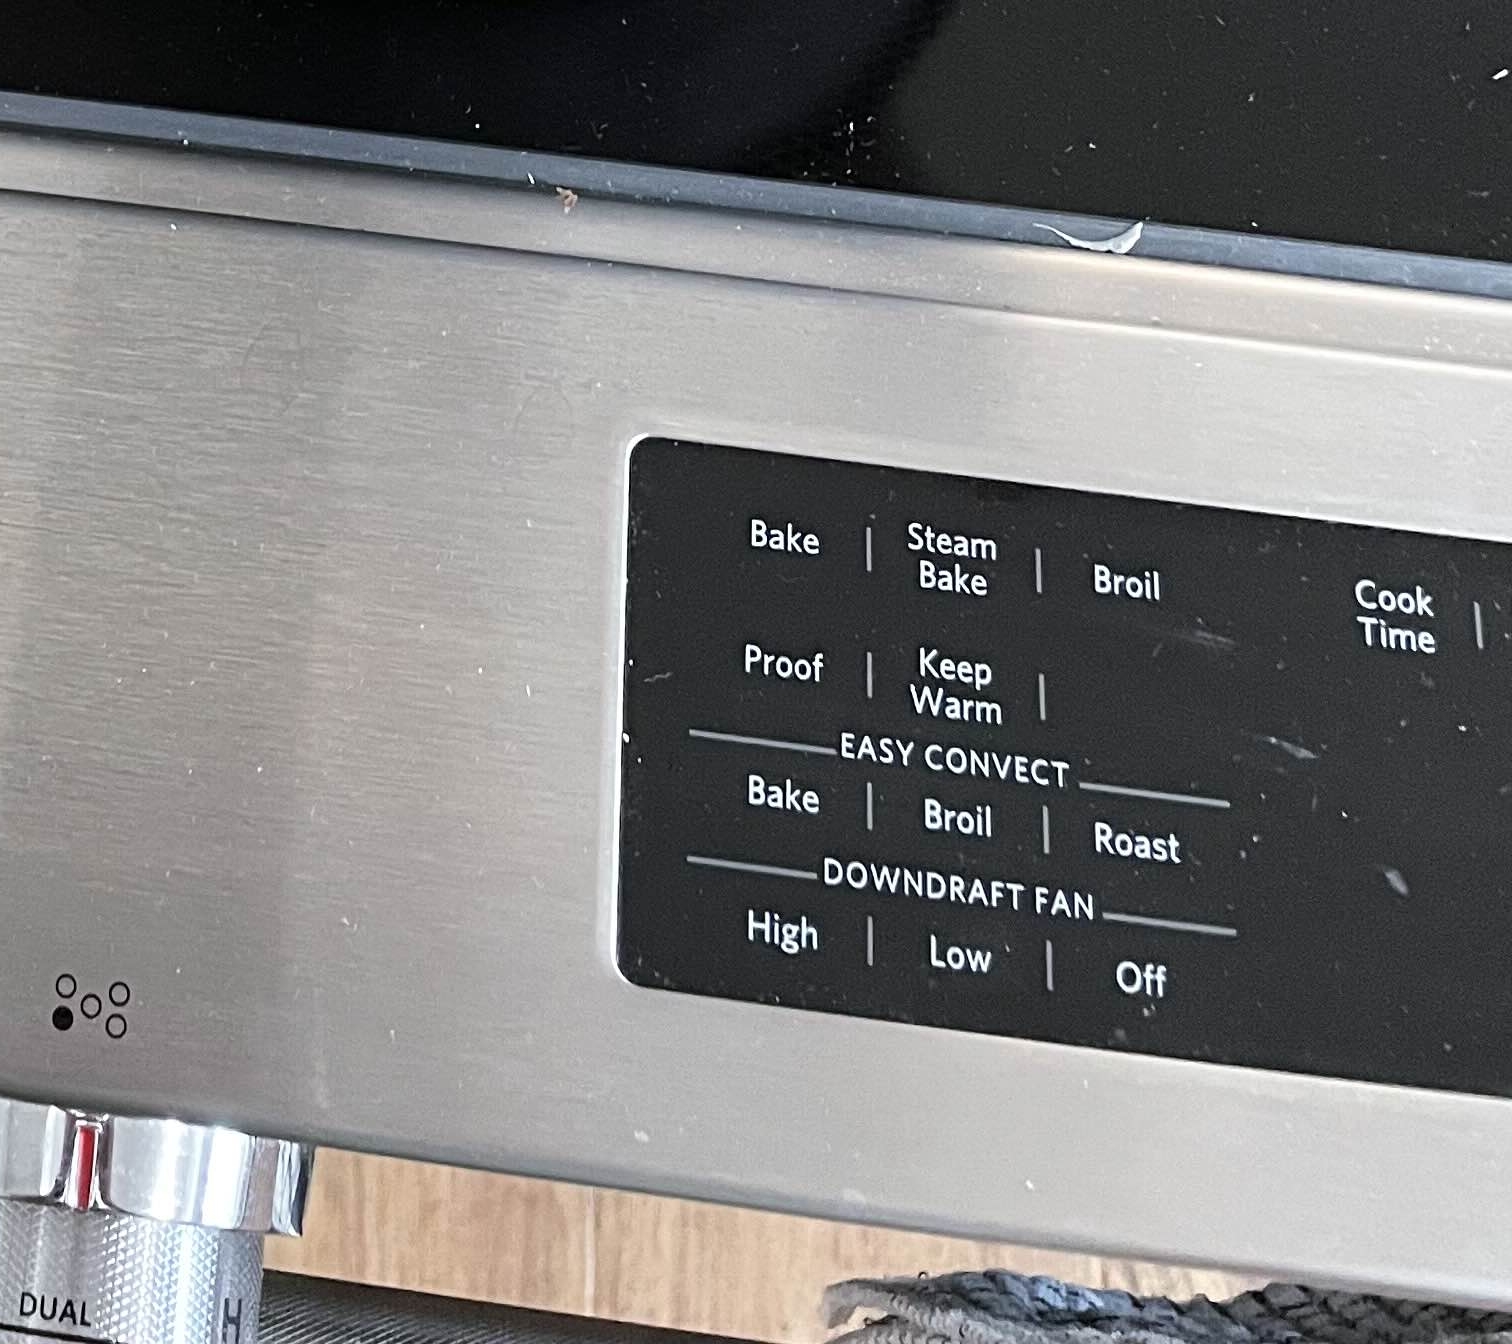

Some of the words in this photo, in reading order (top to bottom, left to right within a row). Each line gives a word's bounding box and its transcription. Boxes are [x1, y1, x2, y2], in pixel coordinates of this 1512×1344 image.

[750, 519, 820, 554] Bake
[908, 523, 997, 561] Steam
[919, 559, 988, 596] Bake
[1093, 564, 1161, 601] Broil
[1354, 579, 1434, 617] Cook
[1356, 616, 1436, 654] Time
[744, 644, 824, 682] Proof
[919, 647, 992, 690] Keep
[910, 684, 1003, 725] Warm
[840, 732, 915, 764] EASY
[923, 743, 1070, 787] CONVECT
[748, 774, 820, 813] Bake
[924, 798, 992, 837] Broil
[1094, 821, 1183, 864] Roast
[823, 857, 1025, 911] DOWNDRAFT
[1034, 886, 1094, 920] FAN
[747, 909, 819, 954] High
[929, 935, 992, 973] Low
[1116, 960, 1167, 998] Off
[19, 1291, 92, 1328] DUAL
[222, 1298, 243, 1344] H
